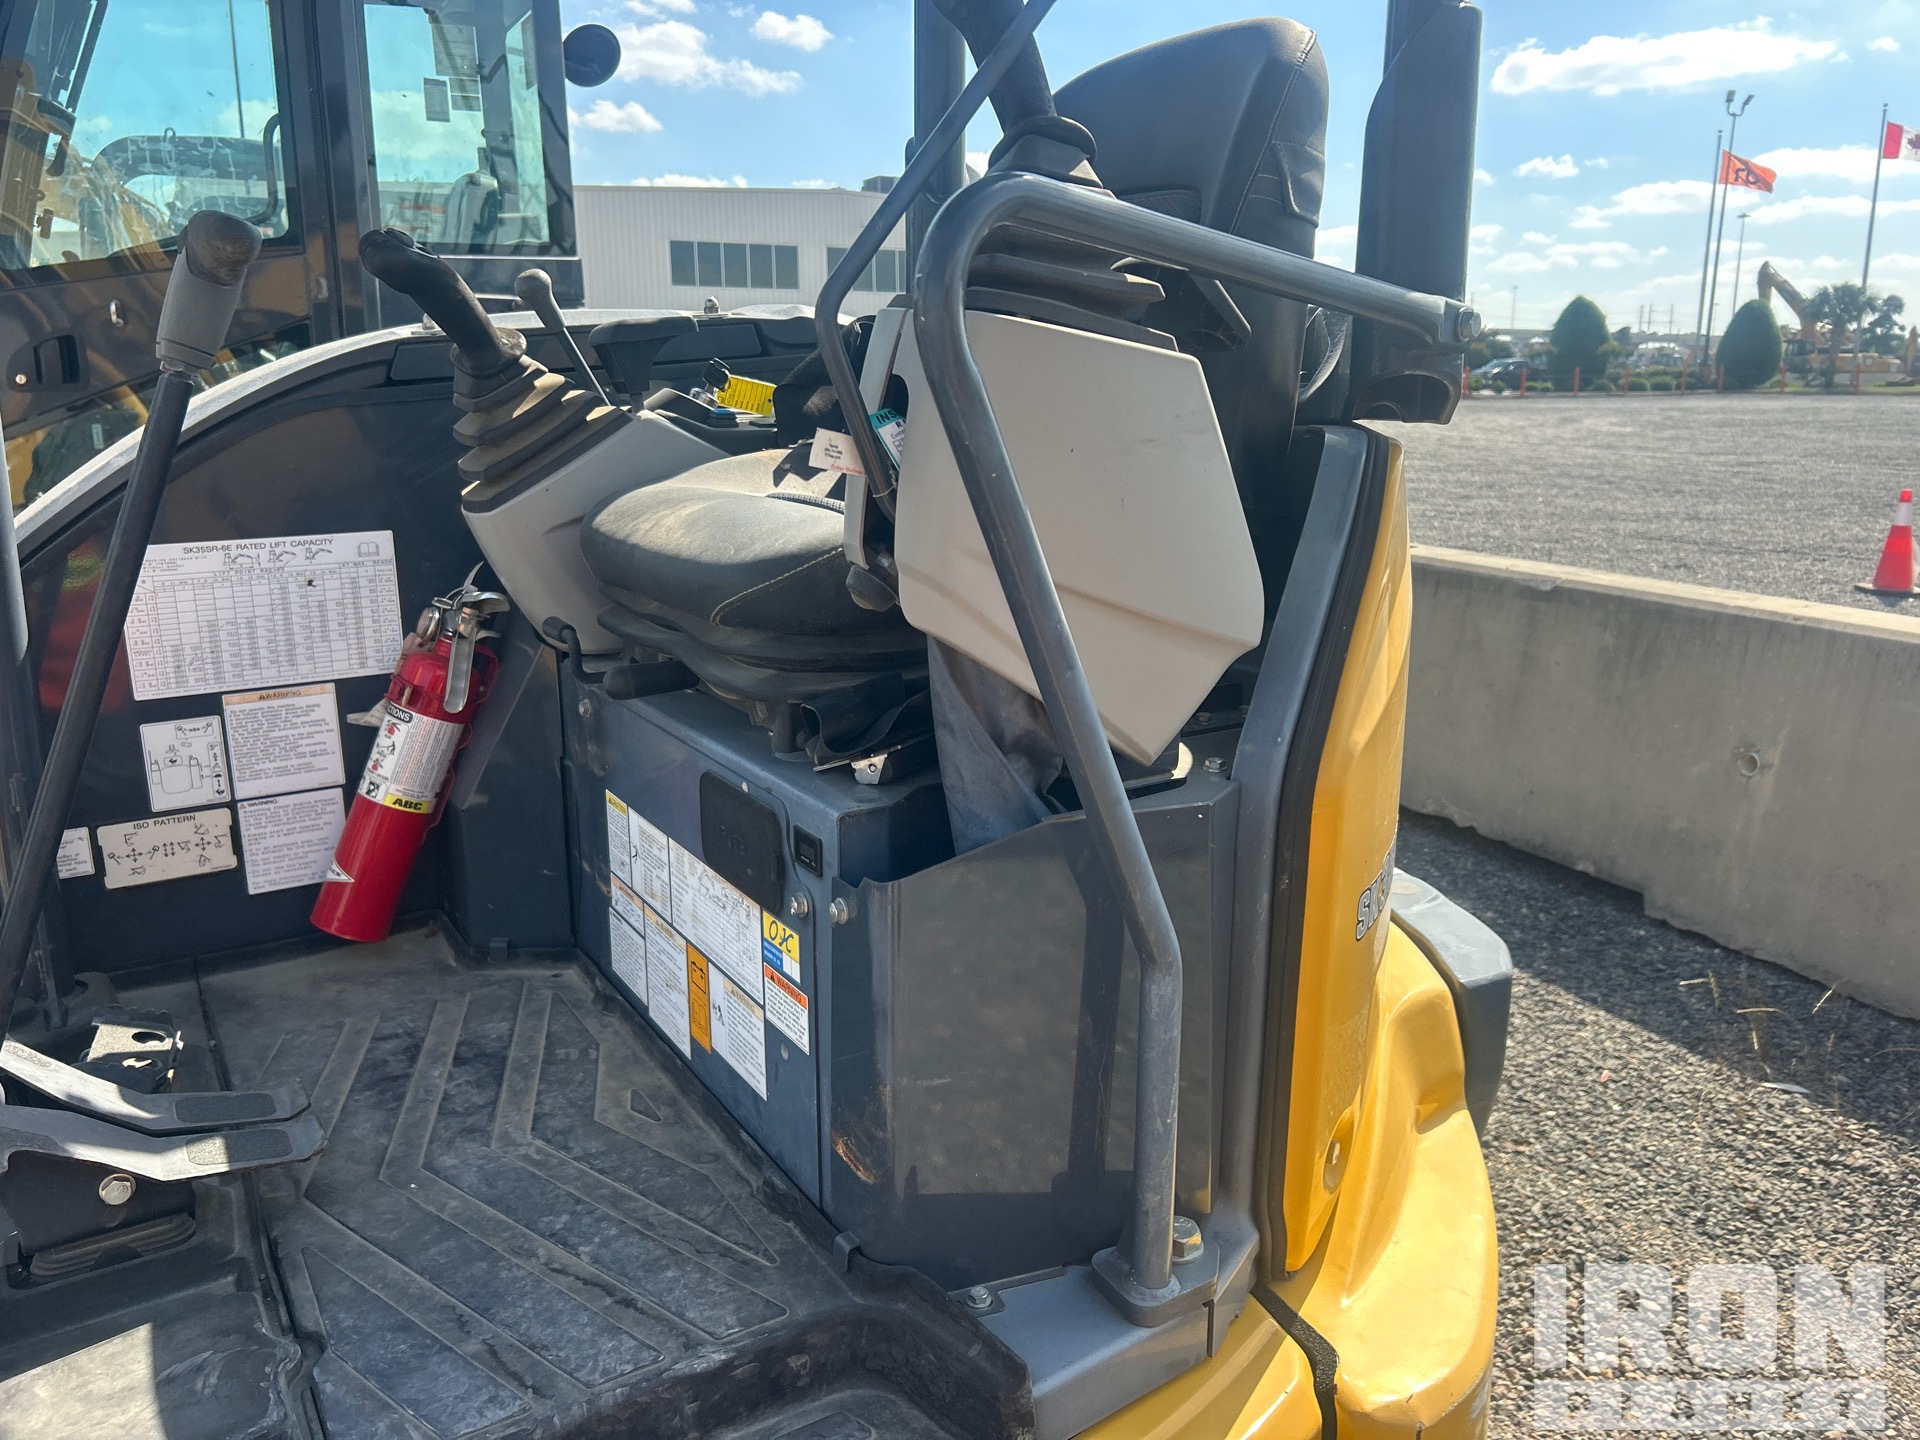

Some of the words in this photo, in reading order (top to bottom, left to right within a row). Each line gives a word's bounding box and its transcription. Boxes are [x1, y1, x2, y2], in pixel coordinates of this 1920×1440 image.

[875, 410, 898, 425] INS
[183, 544, 233, 554] SK35SR-6E
[236, 543, 267, 551] RATED
[270, 541, 287, 549] LIFT
[290, 538, 334, 548] CAPACITY
[247, 799, 278, 808] WARNING
[392, 798, 423, 811] ABC
[133, 820, 149, 830] ISO
[154, 814, 196, 827] PATTERN
[777, 977, 803, 1003] WARNING
